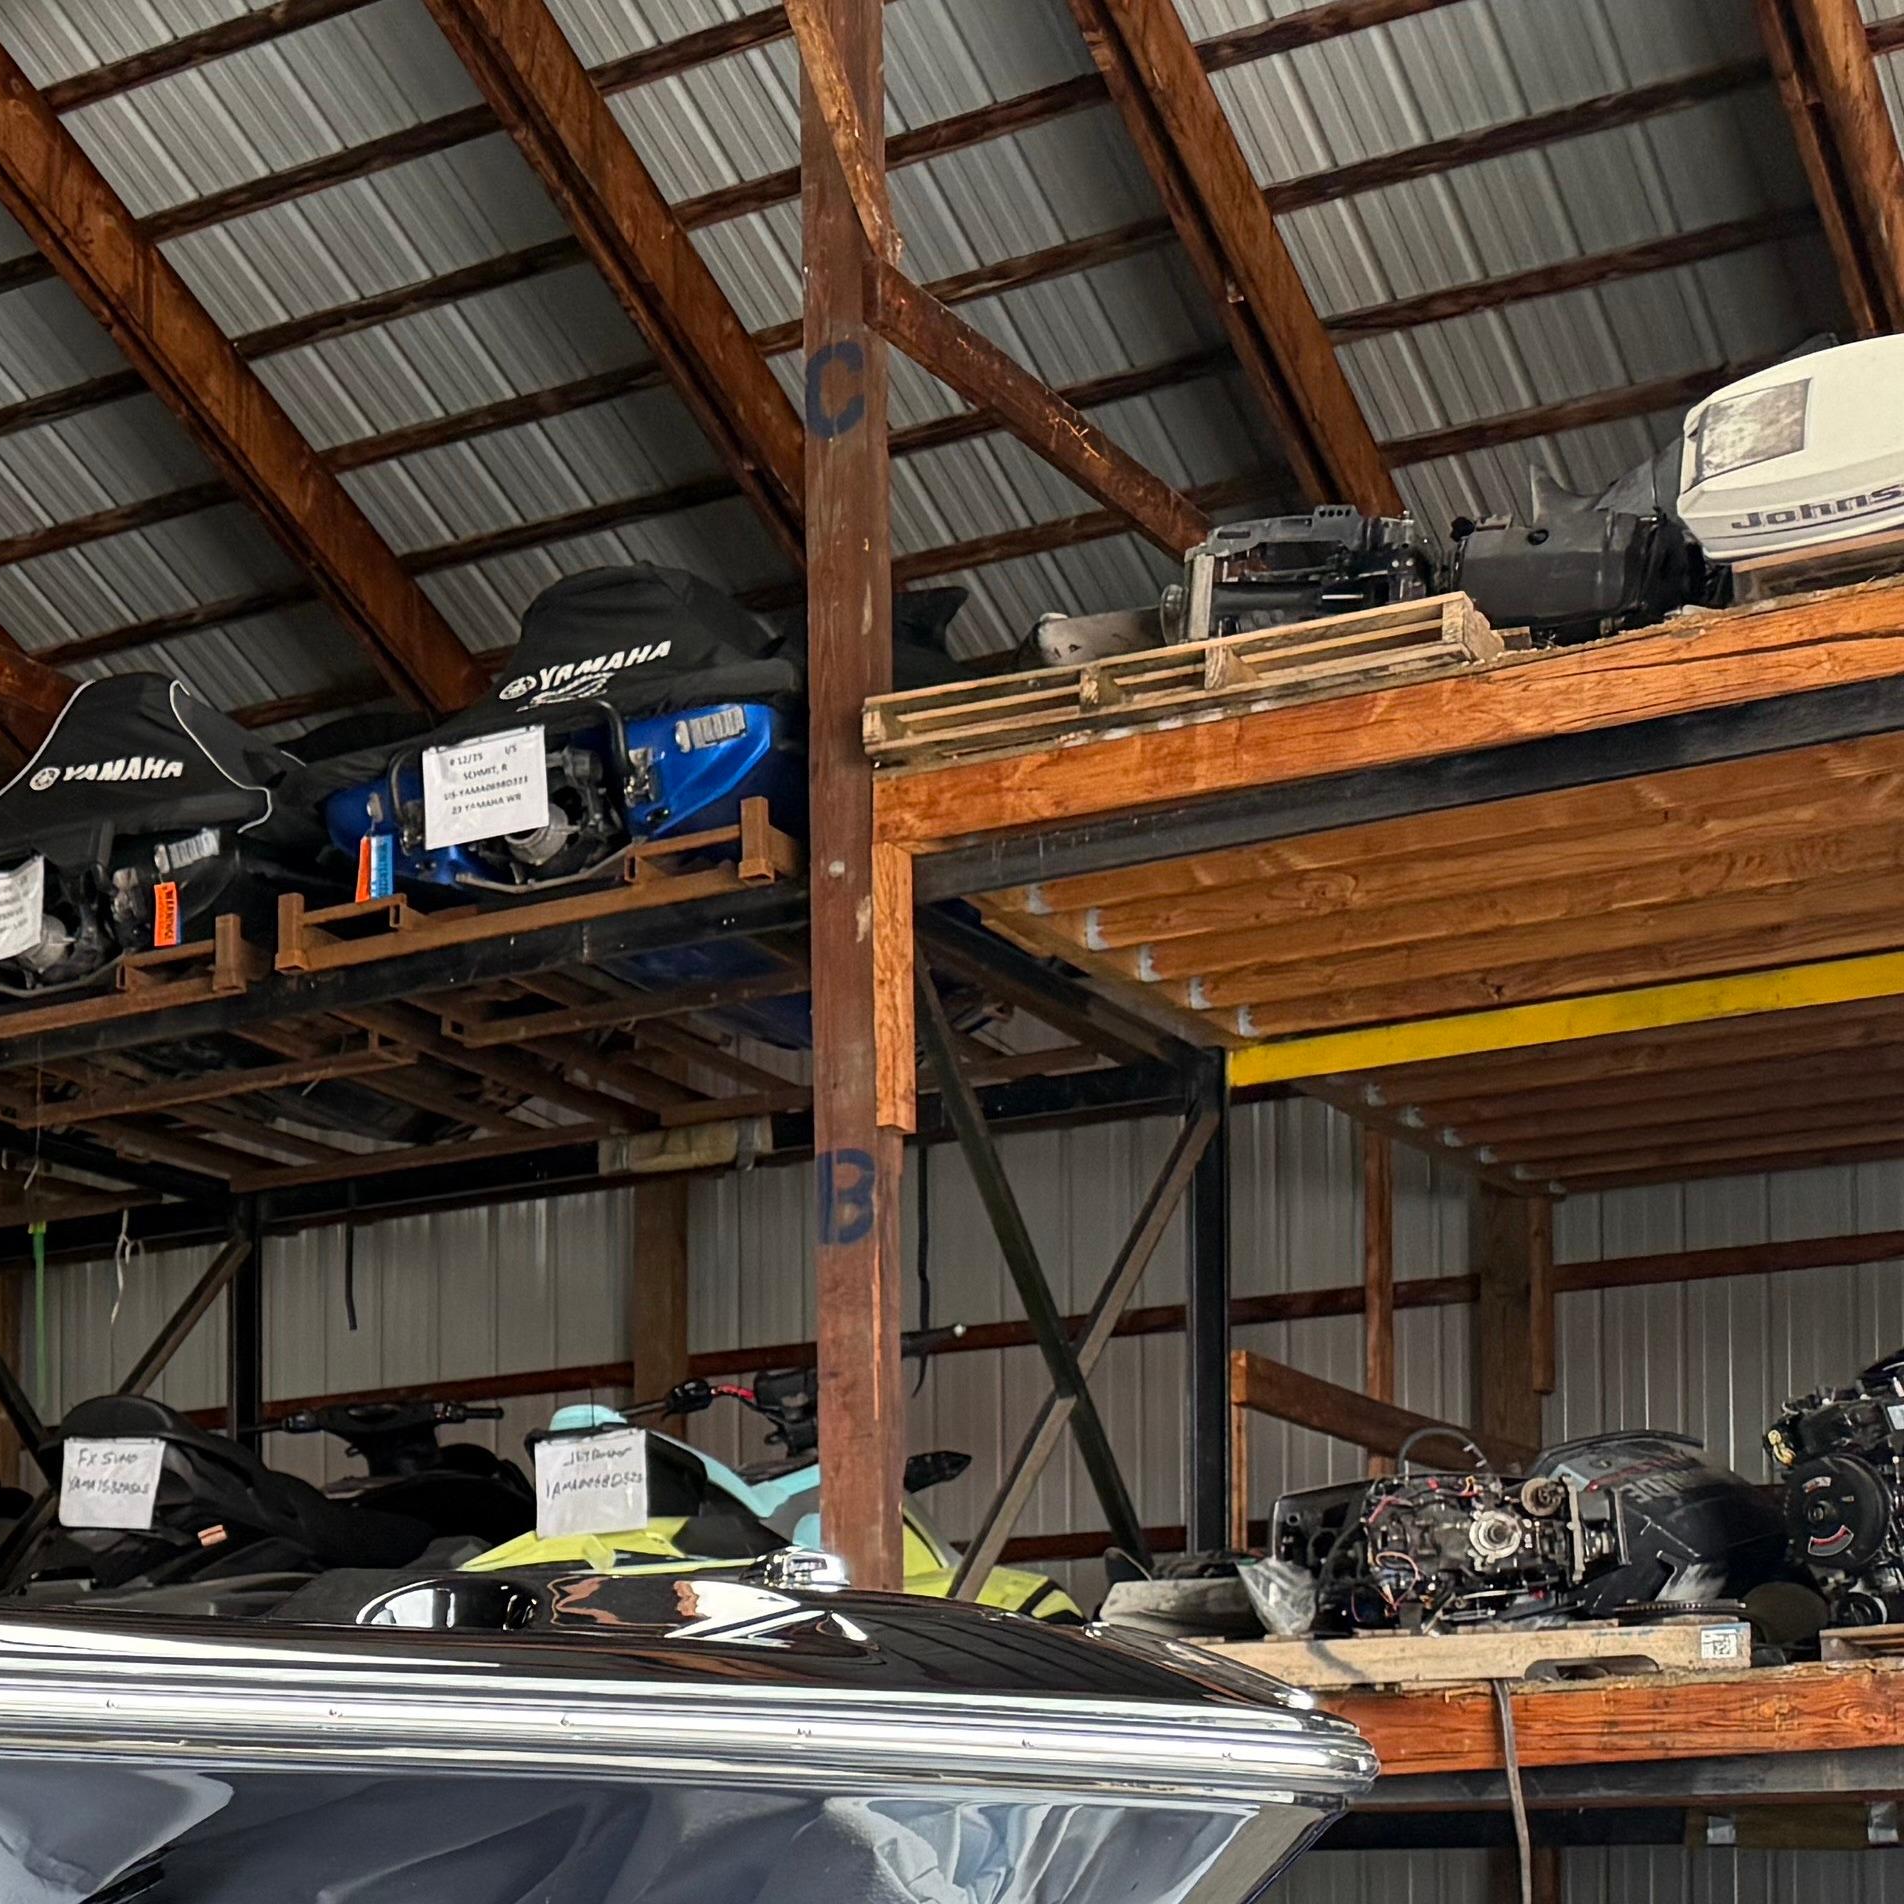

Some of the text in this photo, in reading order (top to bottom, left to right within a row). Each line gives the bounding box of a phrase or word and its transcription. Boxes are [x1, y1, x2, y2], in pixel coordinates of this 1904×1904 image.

[805, 340, 865, 439] C
[539, 640, 671, 691] YAMAHA
[62, 756, 184, 782] YAMAHA
[816, 1148, 875, 1245] B
